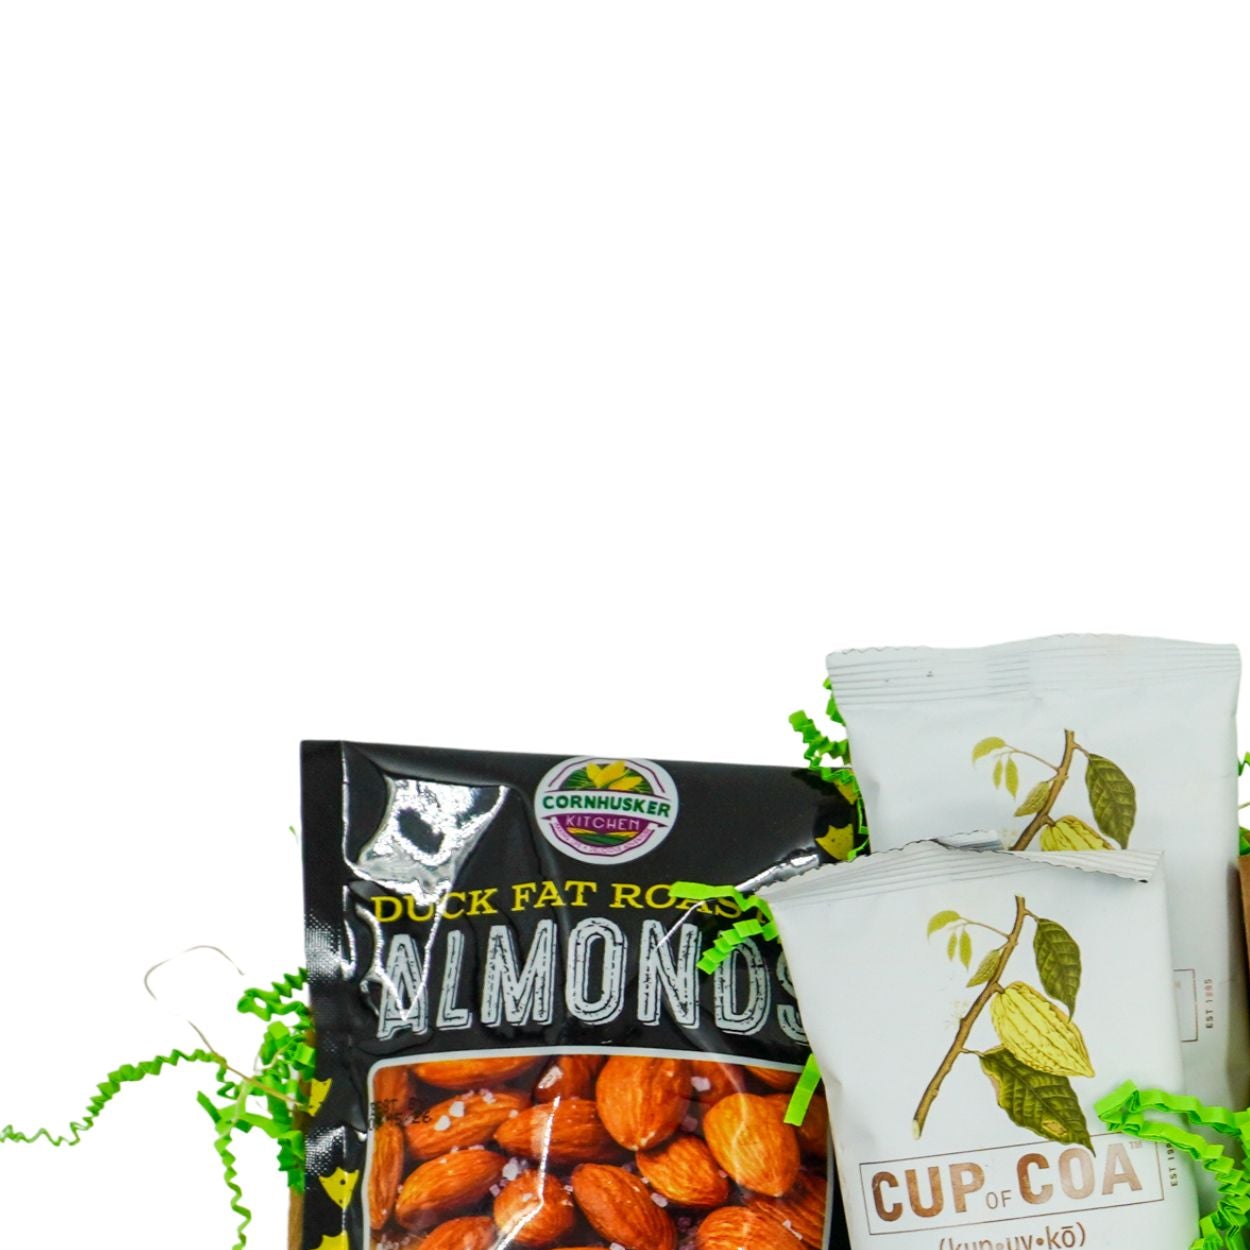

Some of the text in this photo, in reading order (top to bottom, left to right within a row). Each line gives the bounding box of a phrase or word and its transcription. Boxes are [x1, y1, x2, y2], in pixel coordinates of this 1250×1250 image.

[543, 795, 671, 817] CORNHUSKER
[565, 815, 640, 831] KITCHEN
[371, 881, 767, 923] DUCK FAT ROAS
[872, 1142, 1143, 1222] CUP OF COA
